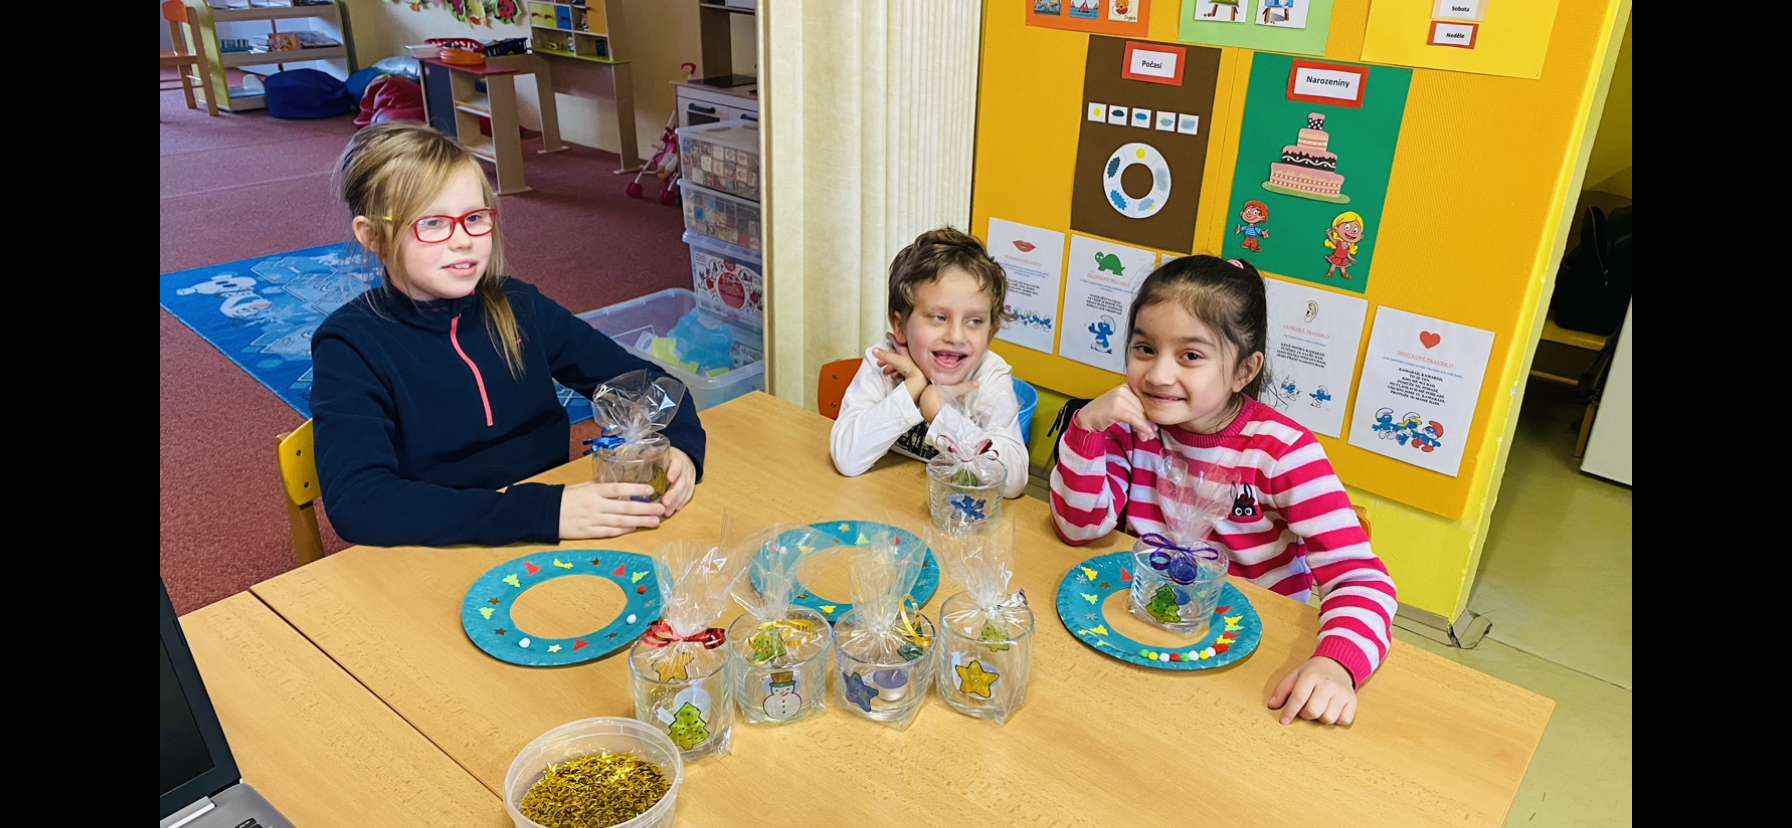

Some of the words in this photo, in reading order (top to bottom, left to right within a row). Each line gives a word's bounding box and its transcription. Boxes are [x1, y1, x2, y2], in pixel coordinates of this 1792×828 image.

[1142, 60, 1162, 69] Počasí
[1306, 76, 1350, 88] Narozeniny
[1427, 358, 1454, 369] PRAVIDLO
